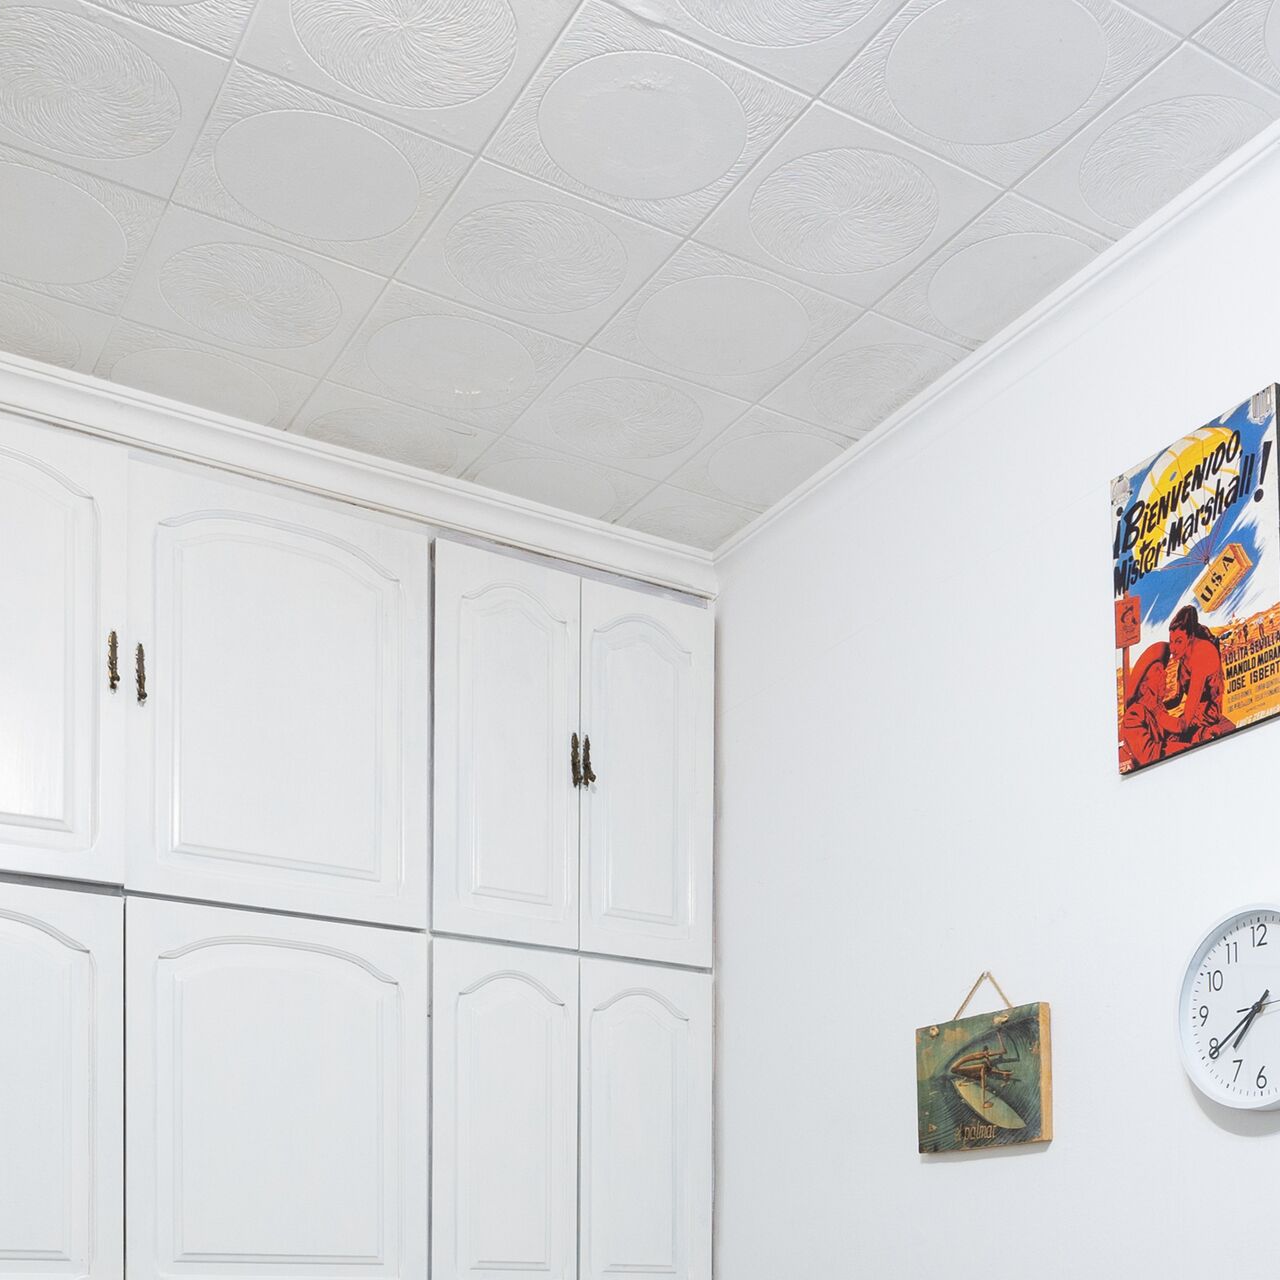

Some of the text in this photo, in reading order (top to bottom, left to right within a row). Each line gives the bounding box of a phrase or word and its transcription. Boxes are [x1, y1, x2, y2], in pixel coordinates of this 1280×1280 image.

[1114, 537, 1168, 597] Mister
[1225, 646, 1249, 665] LOLITA
[1226, 656, 1256, 679] MANOLO
[1227, 676, 1246, 694] JOSE
[1250, 660, 1280, 684] ISBERT
[1251, 923, 1268, 948] 12
[1226, 941, 1238, 965] 11
[1207, 969, 1224, 993] 10
[1199, 1005, 1209, 1027] 9
[1209, 1037, 1219, 1060] 8
[1232, 1058, 1243, 1083] 7
[1256, 1065, 1268, 1090] 6
